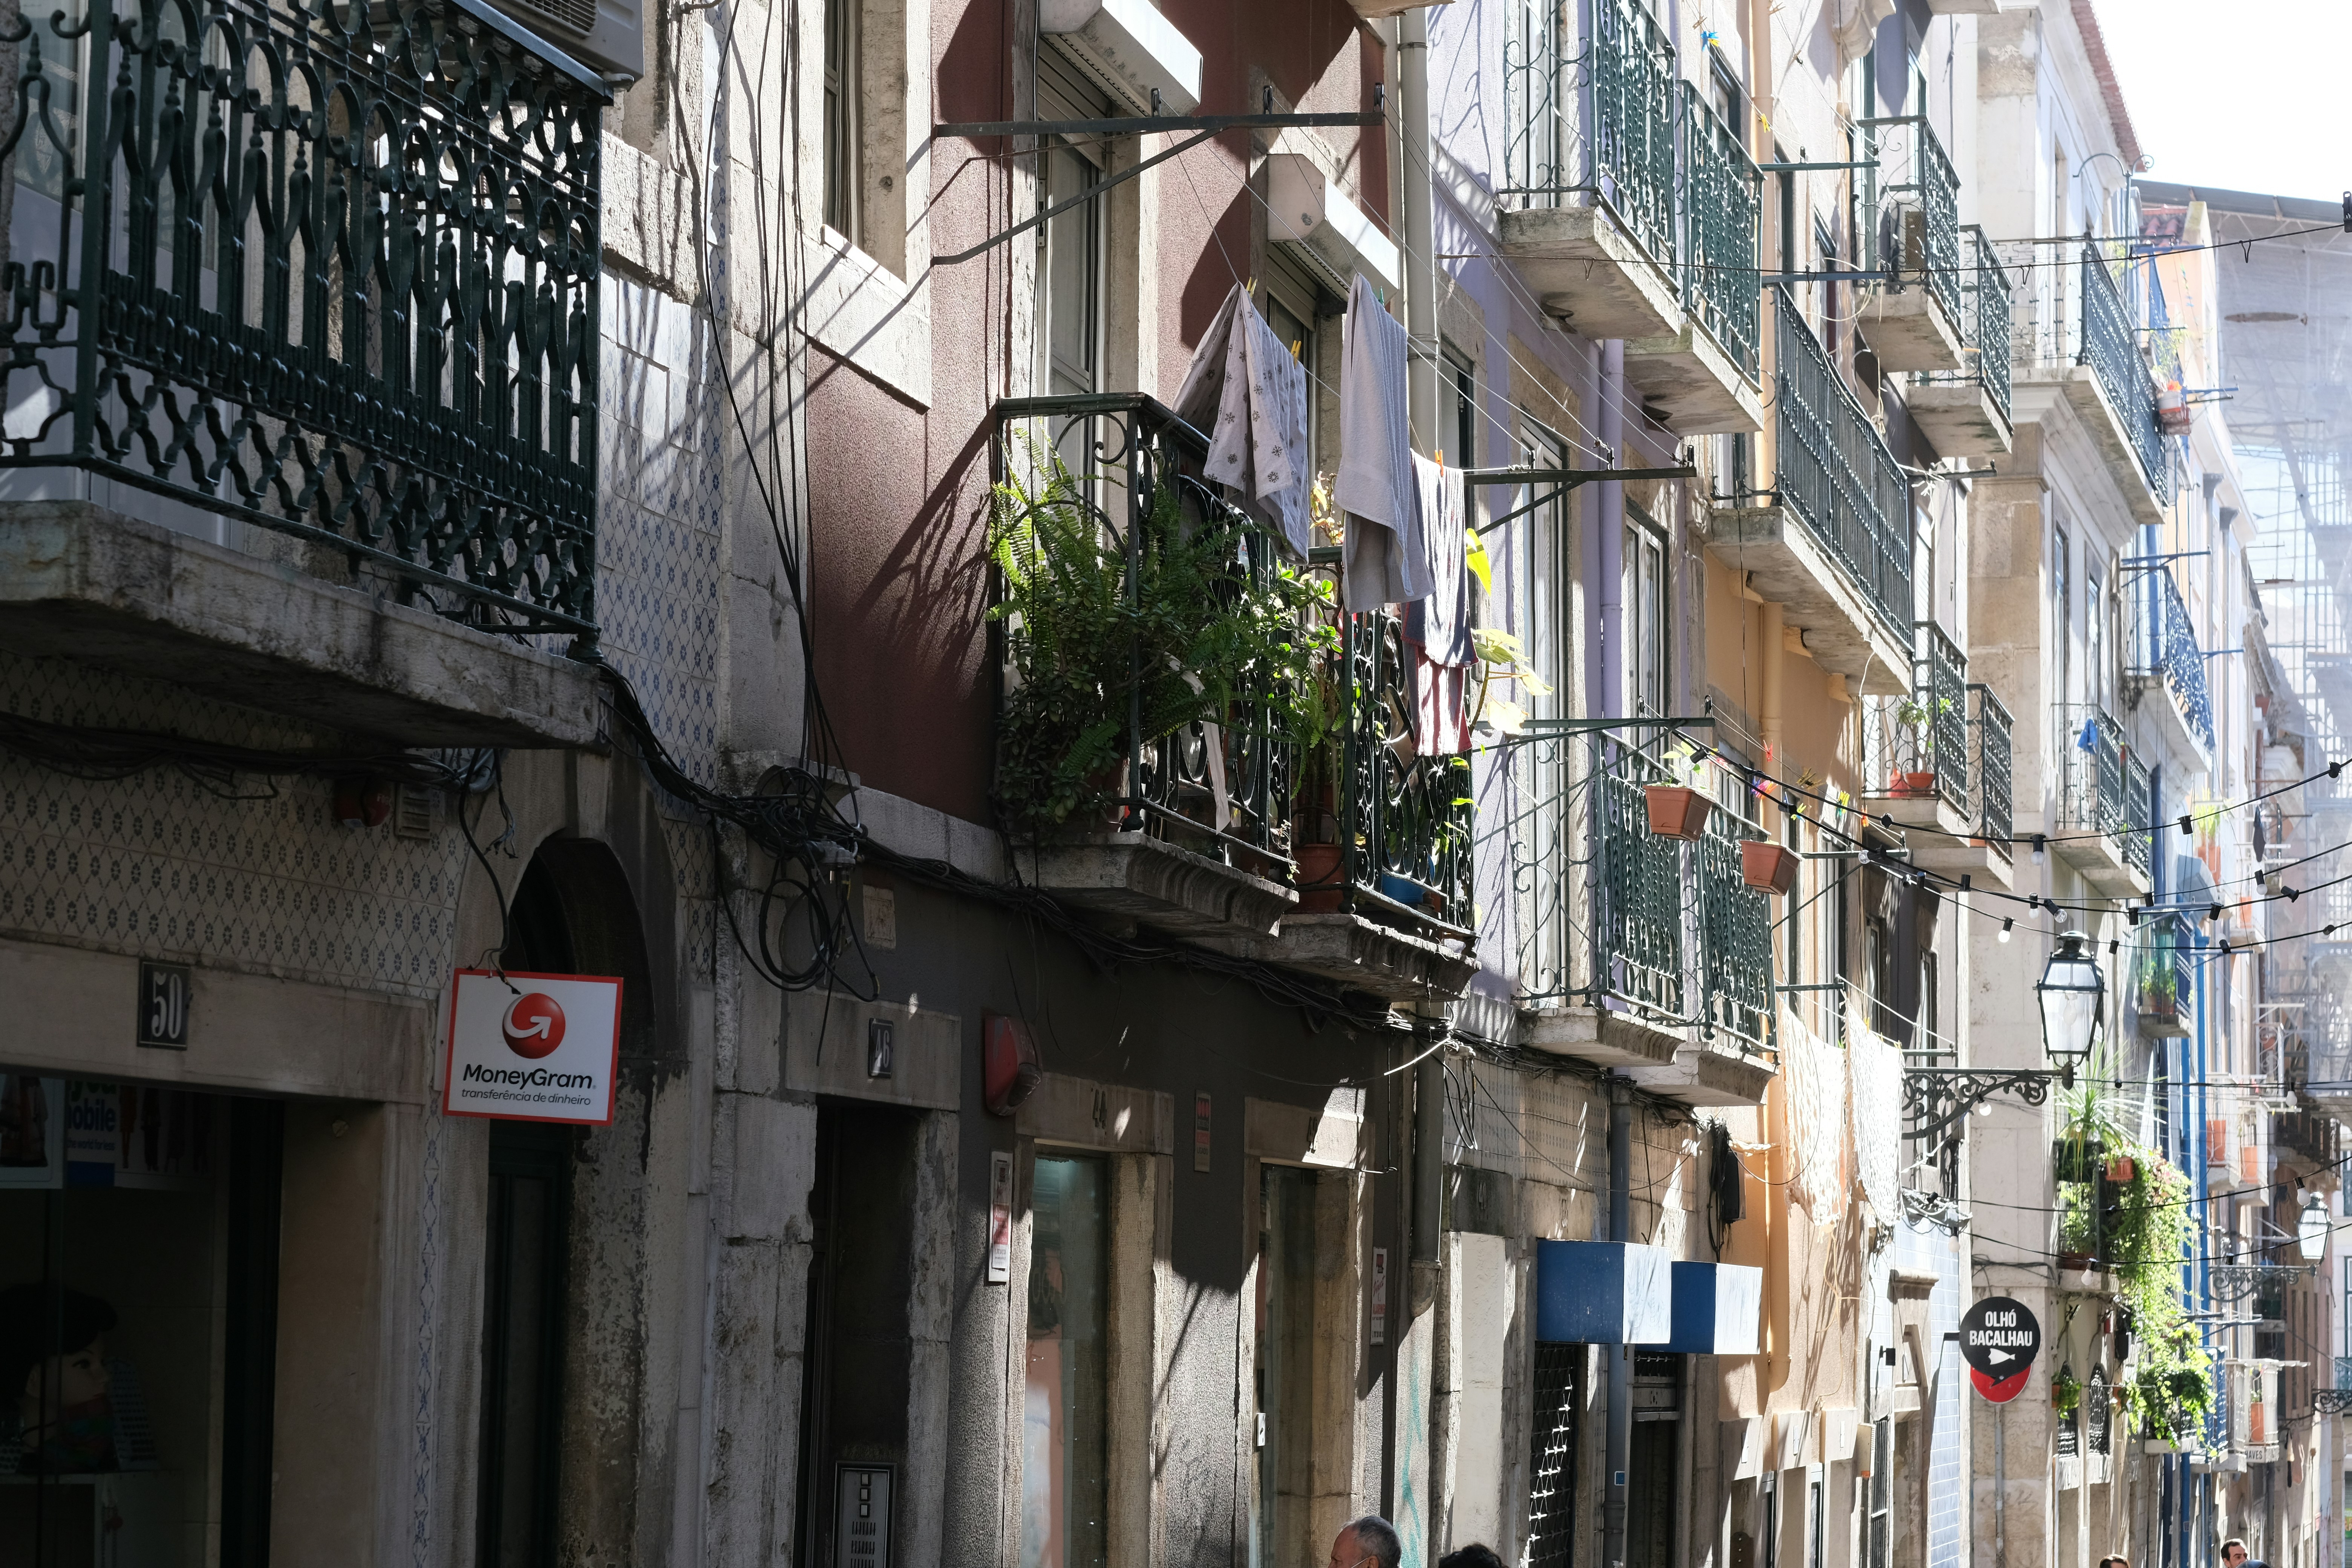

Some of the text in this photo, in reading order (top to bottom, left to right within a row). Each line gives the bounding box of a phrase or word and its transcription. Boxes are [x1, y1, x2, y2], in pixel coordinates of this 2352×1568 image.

[152, 971, 182, 1039] 50
[875, 1028, 890, 1068] 46
[463, 1063, 592, 1090] MoneyGram
[462, 1089, 591, 1105] transferência de dinheiro
[1985, 1309, 2016, 1327] OLHÓ
[1969, 1330, 2033, 1347] BACALHAU
[2245, 1450, 2263, 1459] HAVES
